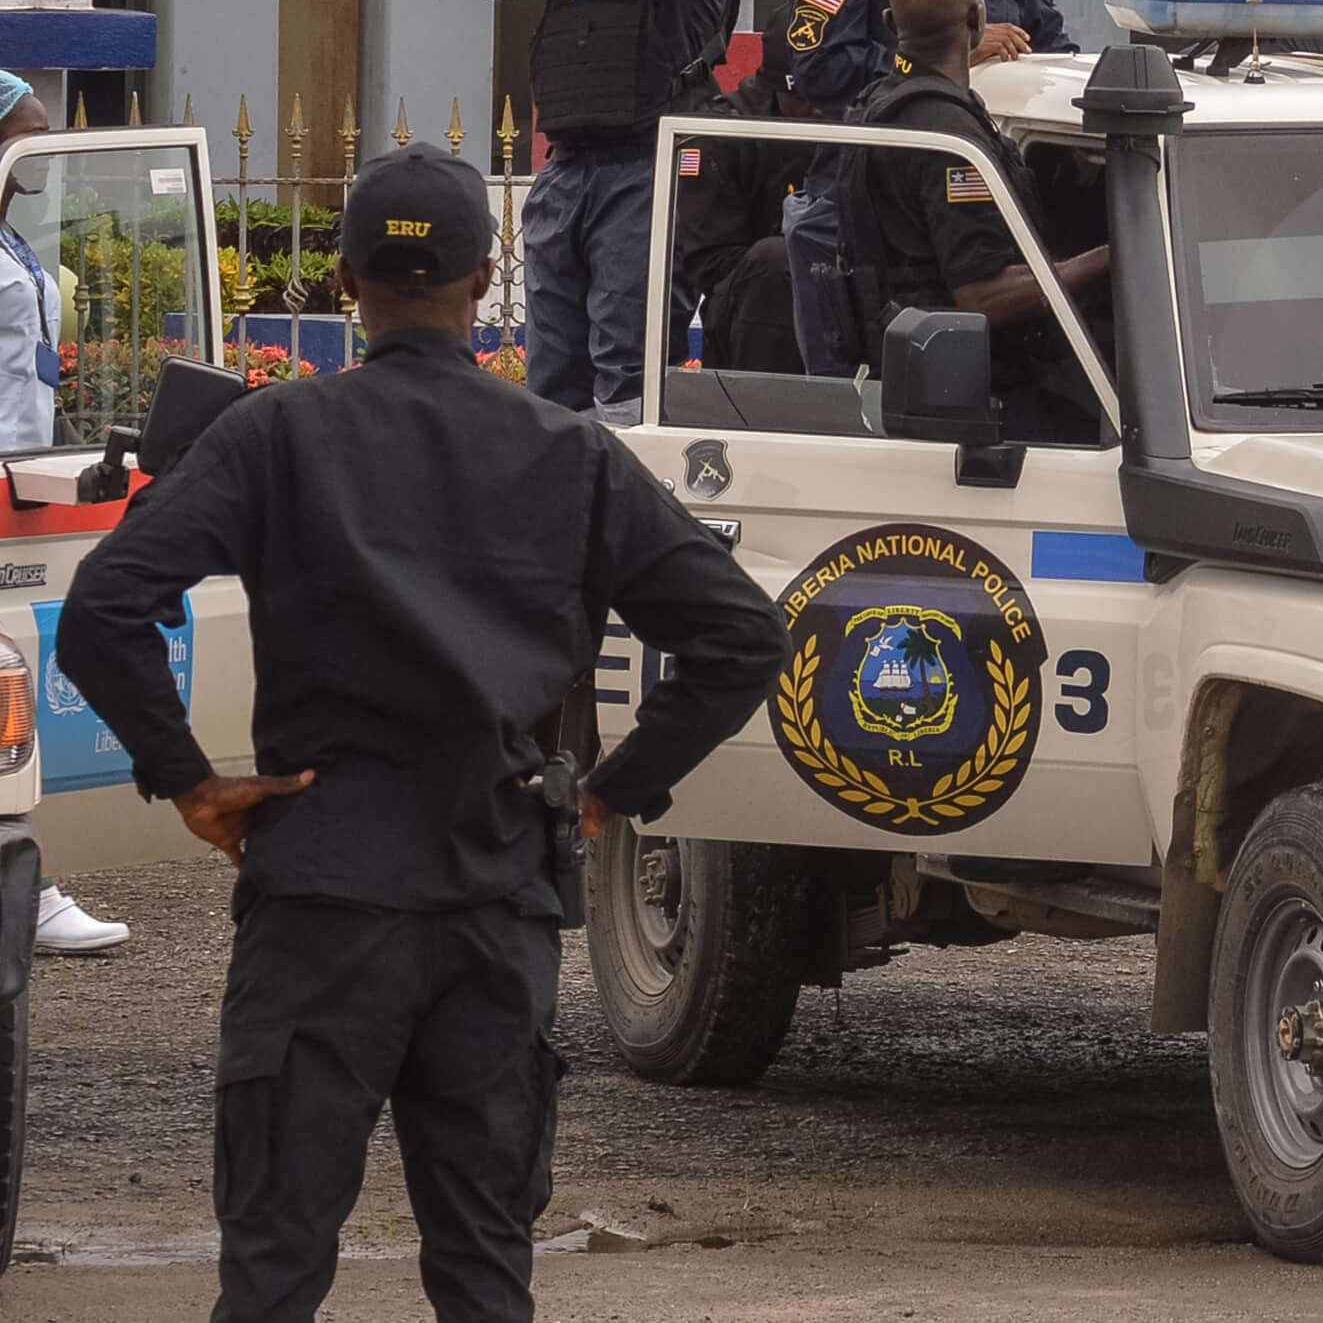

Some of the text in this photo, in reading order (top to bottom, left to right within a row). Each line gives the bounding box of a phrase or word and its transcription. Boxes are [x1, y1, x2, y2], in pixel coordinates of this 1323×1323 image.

[895, 53, 913, 74] PU
[386, 220, 431, 237] ERU
[856, 534, 967, 572] NATIONAL
[971, 561, 1032, 643] POLICE
[1055, 650, 1110, 734] 3
[96, 732, 123, 753] Libe
[888, 749, 923, 767] R.L
